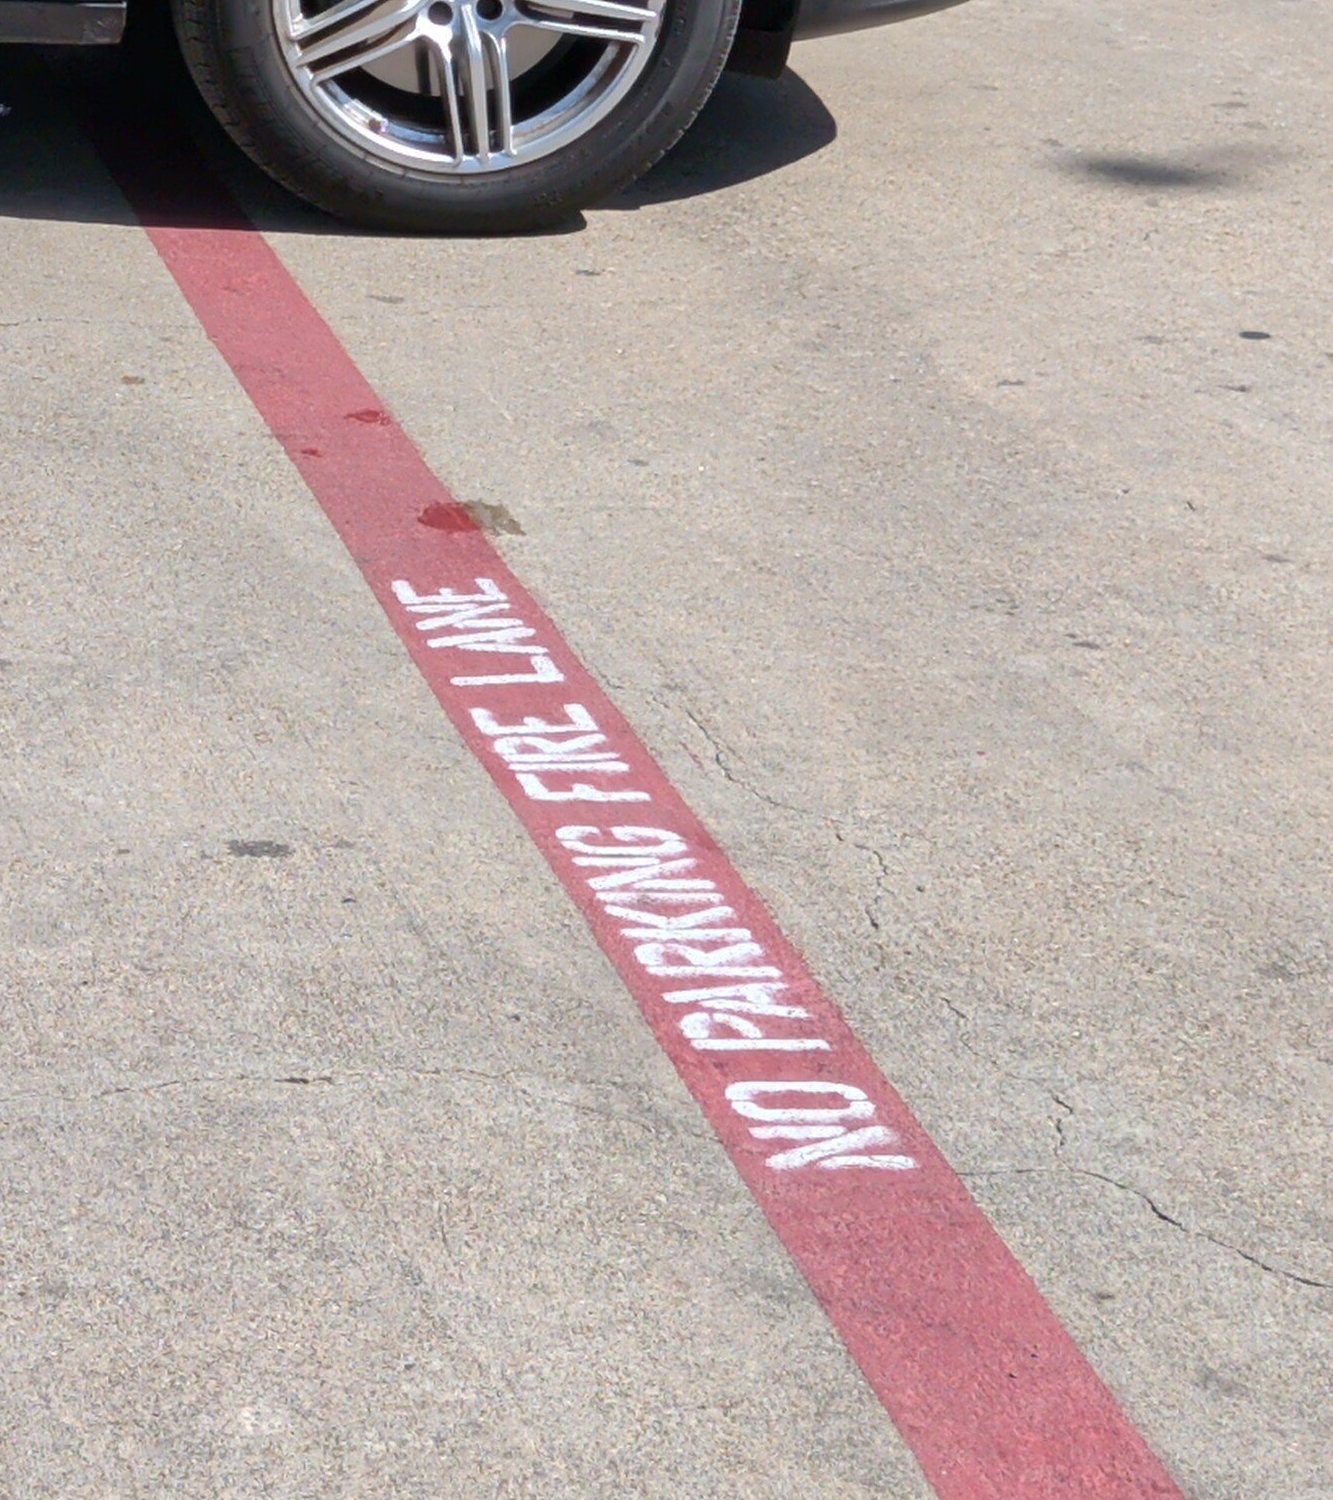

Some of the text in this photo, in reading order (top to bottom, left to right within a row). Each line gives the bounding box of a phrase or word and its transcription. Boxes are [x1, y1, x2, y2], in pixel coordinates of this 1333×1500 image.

[390, 577, 916, 1170] NO PARKING FIRE LANE
